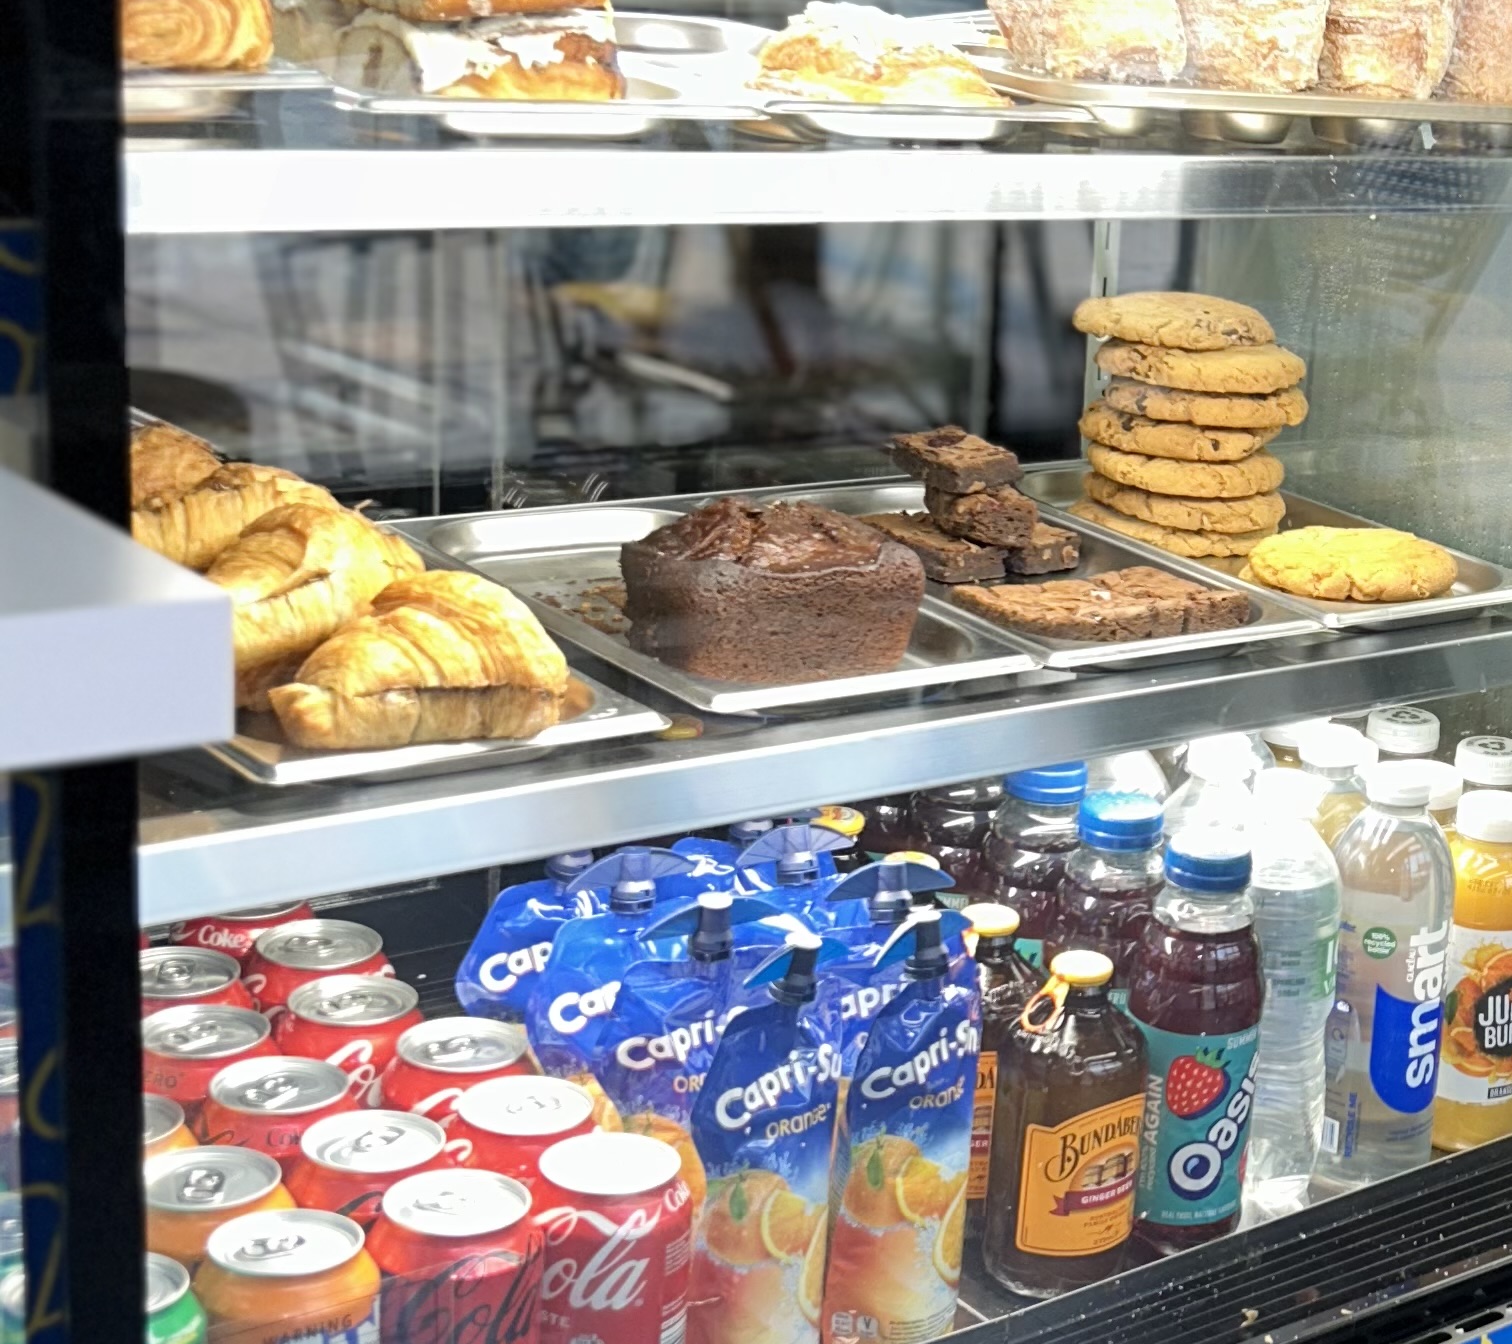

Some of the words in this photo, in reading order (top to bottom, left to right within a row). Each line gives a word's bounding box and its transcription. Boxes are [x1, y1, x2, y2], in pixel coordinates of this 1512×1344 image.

[198, 924, 246, 948] Coke
[1405, 920, 1448, 1089] smart
[715, 1043, 842, 1130] Capri-Su
